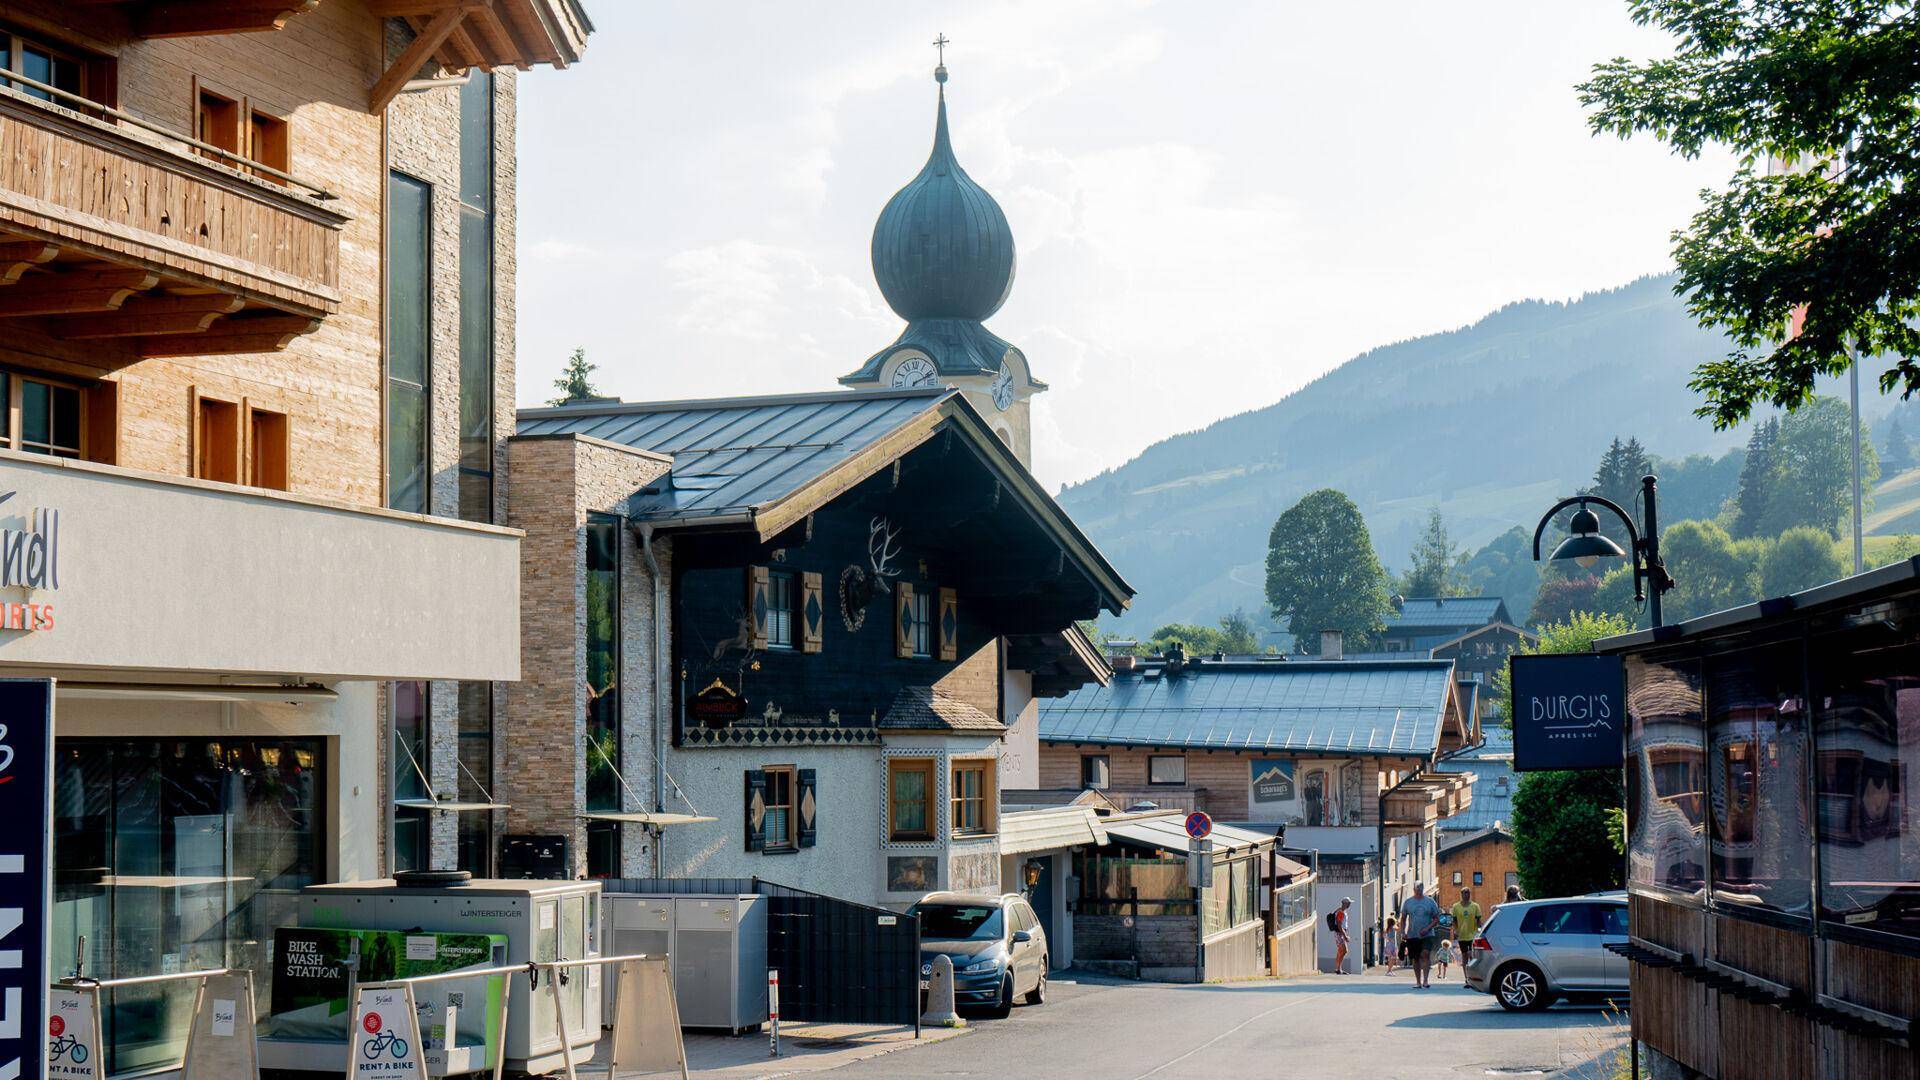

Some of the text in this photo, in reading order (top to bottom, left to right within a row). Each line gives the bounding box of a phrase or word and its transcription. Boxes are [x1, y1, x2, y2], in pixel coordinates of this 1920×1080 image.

[0, 504, 59, 591] ndl
[1532, 695, 1611, 721] BURGI'S
[460, 910, 522, 918] WINTERSTEIGER
[288, 940, 317, 953] BIKE
[286, 953, 324, 966] WASH
[286, 965, 341, 979] STATION.
[49, 1065, 61, 1073] NT
[71, 1067, 92, 1075] BIKE
[360, 1063, 383, 1071] RENT
[393, 1061, 413, 1070] BIKE
